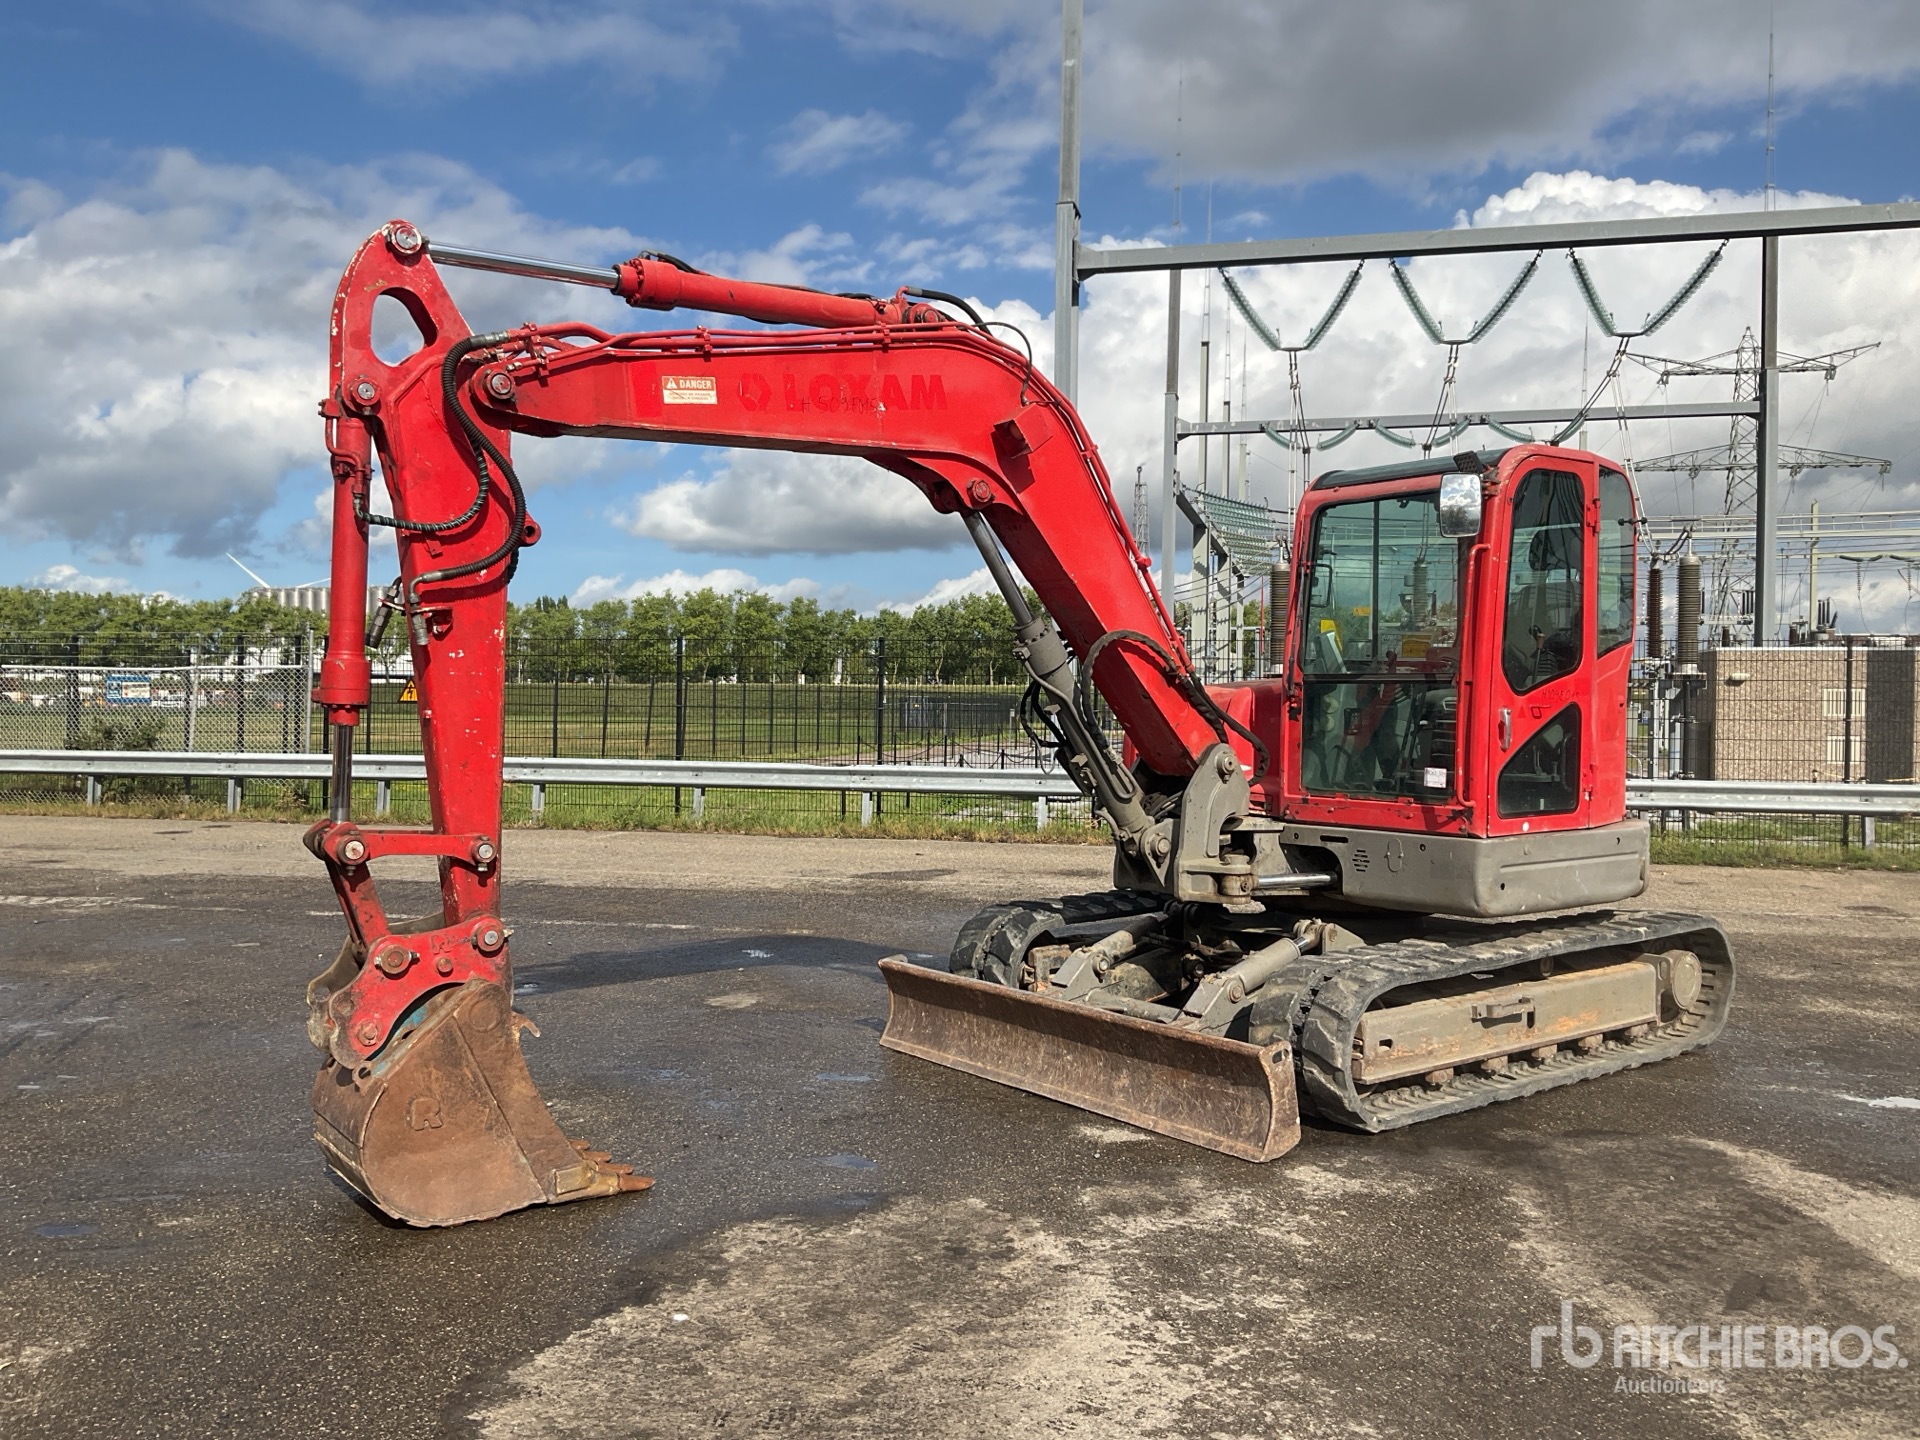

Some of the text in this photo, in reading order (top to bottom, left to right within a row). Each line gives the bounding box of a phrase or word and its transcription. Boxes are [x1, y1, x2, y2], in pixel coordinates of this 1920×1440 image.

[679, 379, 712, 389] DANGER
[783, 373, 948, 412] LOXAM
[410, 1097, 444, 1131] R
